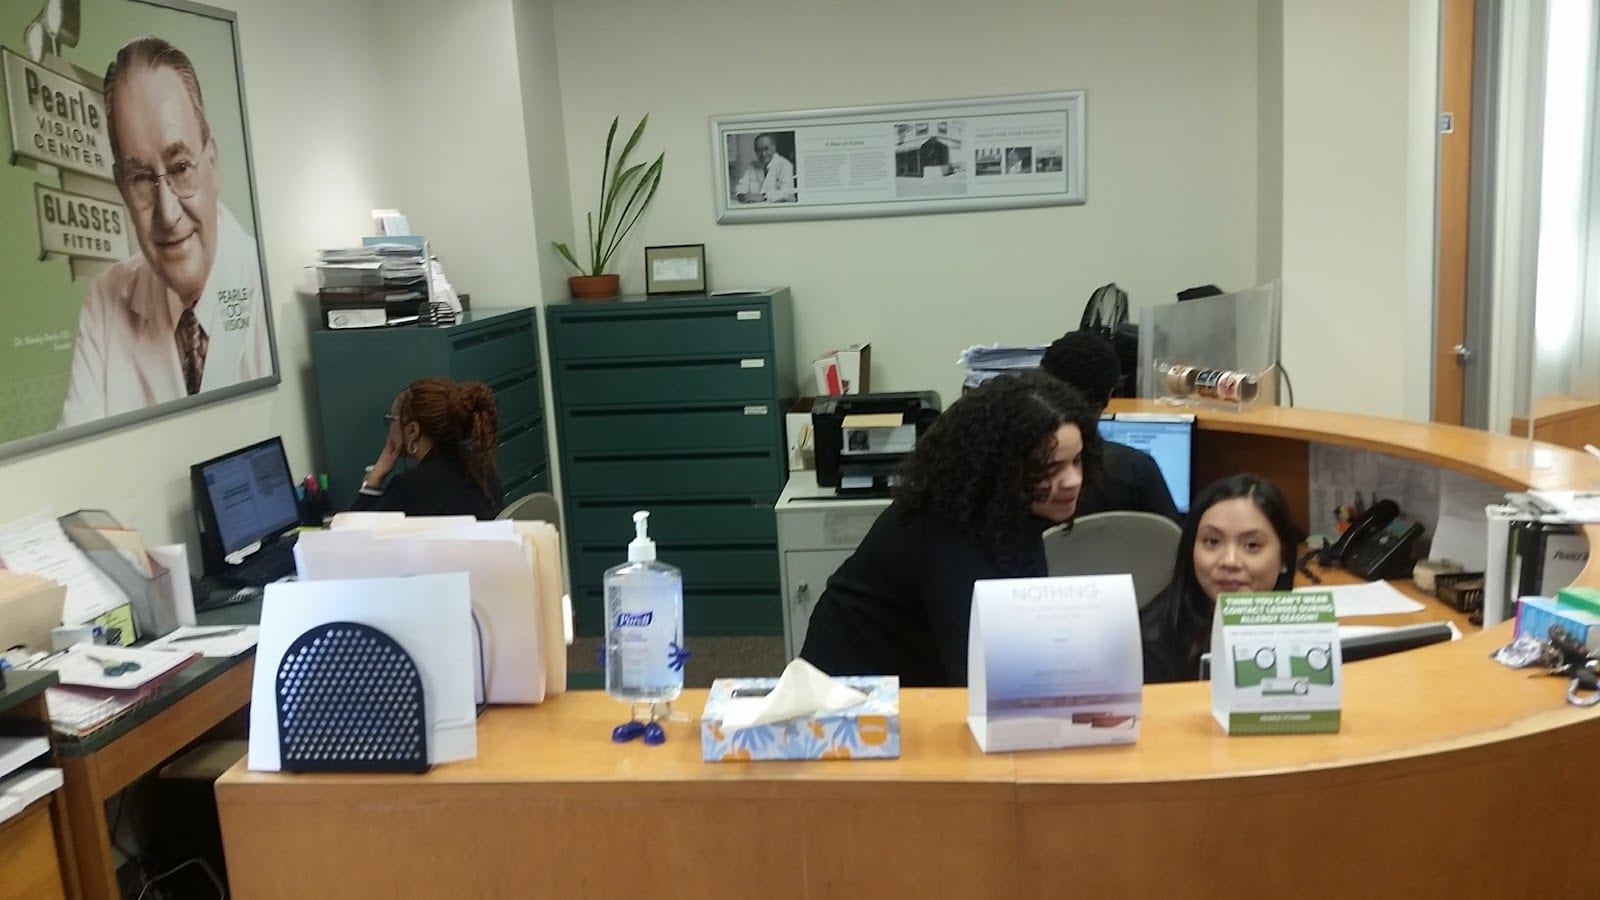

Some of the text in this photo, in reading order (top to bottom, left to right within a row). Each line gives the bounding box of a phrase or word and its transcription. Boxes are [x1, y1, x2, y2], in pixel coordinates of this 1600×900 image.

[24, 66, 99, 130] Pearle
[36, 115, 96, 147] VISION
[33, 133, 104, 168] CENTER
[43, 194, 122, 235] GLASSES
[63, 232, 111, 252] FITTED
[217, 287, 248, 304] PEARLE
[223, 316, 250, 331] VISION
[1011, 583, 1099, 601] NOTHING
[1255, 596, 1275, 606] YOU
[1302, 594, 1329, 604] WEAR
[1223, 605, 1265, 616] CONTACT
[1240, 613, 1279, 624] ALLERGY
